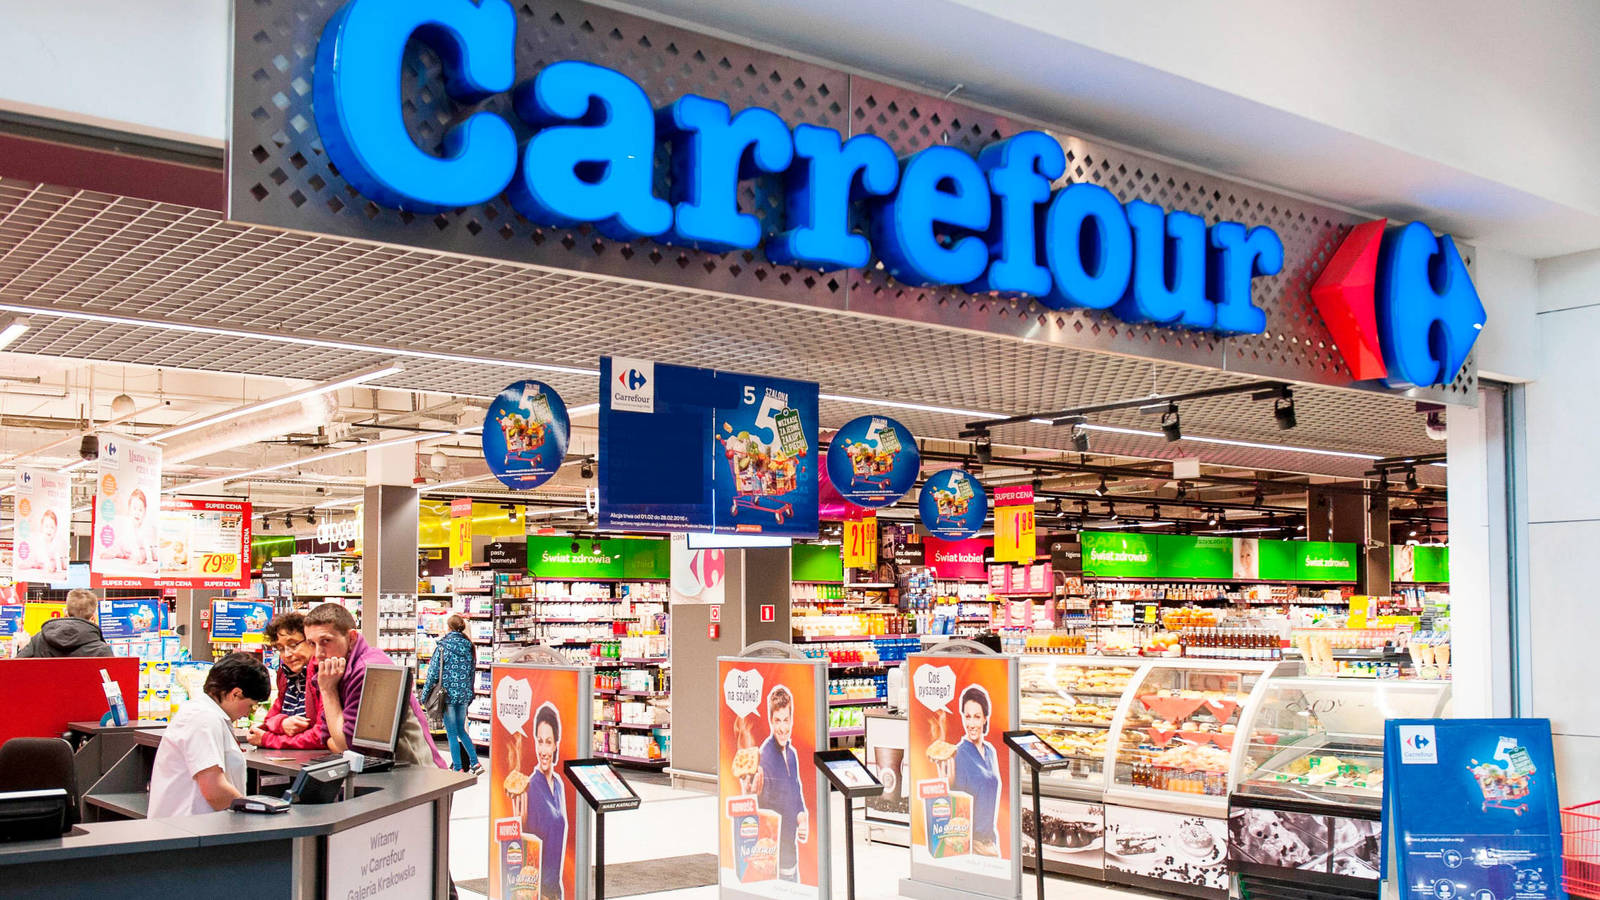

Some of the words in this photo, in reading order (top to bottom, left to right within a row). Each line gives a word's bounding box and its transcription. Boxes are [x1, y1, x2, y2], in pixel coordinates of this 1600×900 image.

[313, 0, 1284, 336] Carrefour
[614, 393, 650, 404] Carrefour
[743, 385, 756, 405] 5
[995, 491, 1015, 501] SUPER
[1016, 490, 1033, 499] CENA
[542, 552, 570, 564] Świat
[572, 553, 611, 565] zdrowia
[935, 550, 958, 562] Świat
[958, 552, 984, 563] kobiet
[1090, 547, 1113, 561] Świat
[1115, 550, 1147, 562] zdrowia
[737, 674, 749, 689] Coś
[928, 671, 940, 684] Coś
[728, 691, 735, 701] na
[736, 688, 759, 704] szybko?
[918, 684, 951, 699] pysznego?
[370, 830, 399, 850] Witamy
[361, 863, 368, 876] w
[369, 848, 405, 873] Carrefour
[347, 880, 376, 900] Galeria
[377, 864, 416, 892] Krakowska
